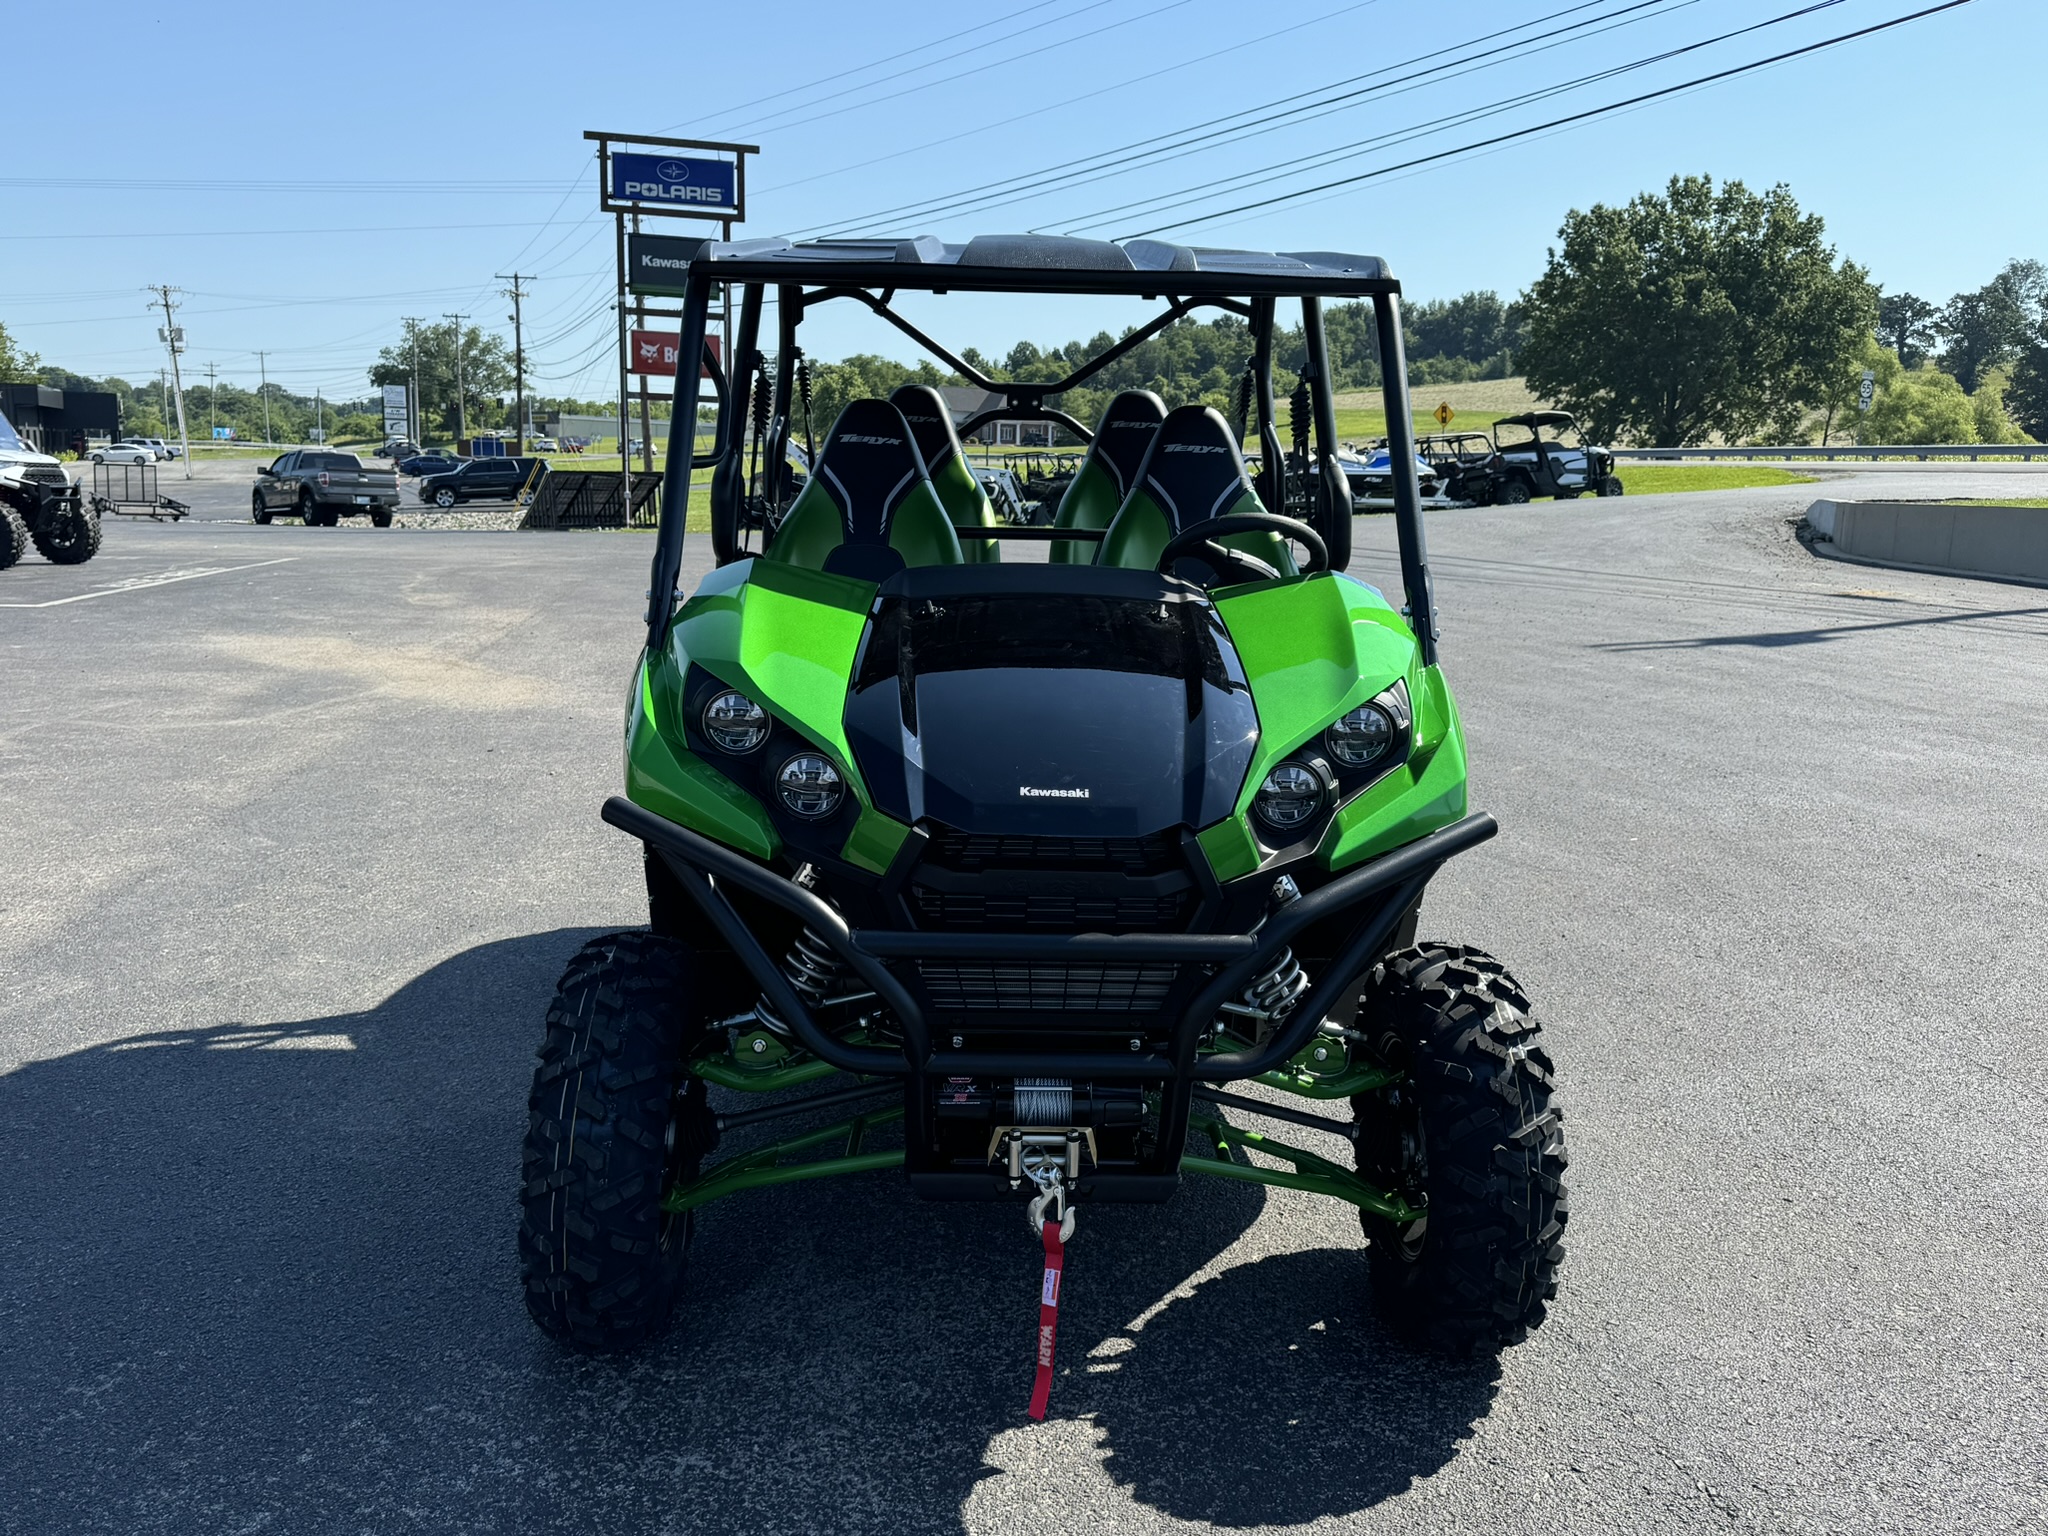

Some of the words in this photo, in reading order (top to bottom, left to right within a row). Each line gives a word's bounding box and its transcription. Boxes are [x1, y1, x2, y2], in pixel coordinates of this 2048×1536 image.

[625, 181, 722, 202] POLARIS
[1019, 786, 1090, 798] Kawasaki
[1039, 1325, 1053, 1367] WARN
